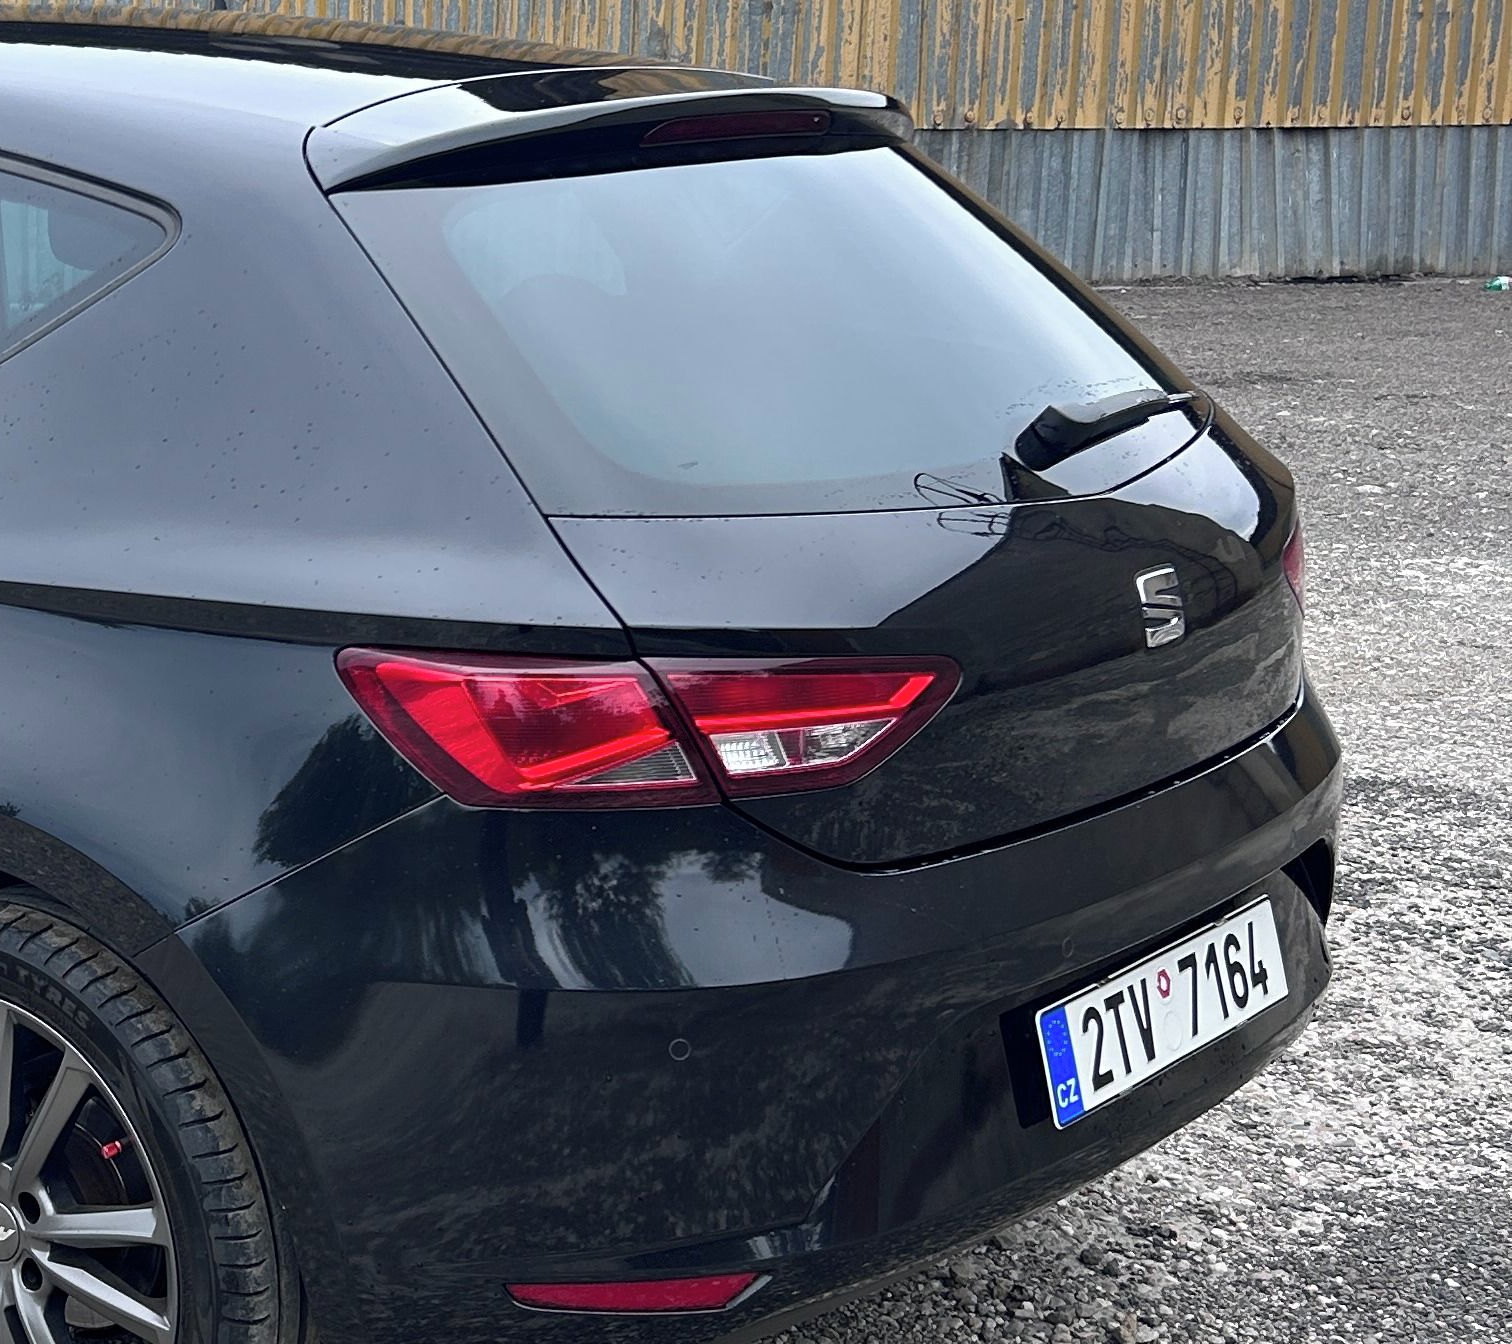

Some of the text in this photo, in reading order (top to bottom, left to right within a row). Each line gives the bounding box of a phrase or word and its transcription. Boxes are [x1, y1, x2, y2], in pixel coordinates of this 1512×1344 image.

[1082, 921, 1268, 1092] 2TV 7164
[1056, 1078, 1079, 1108] CZ
